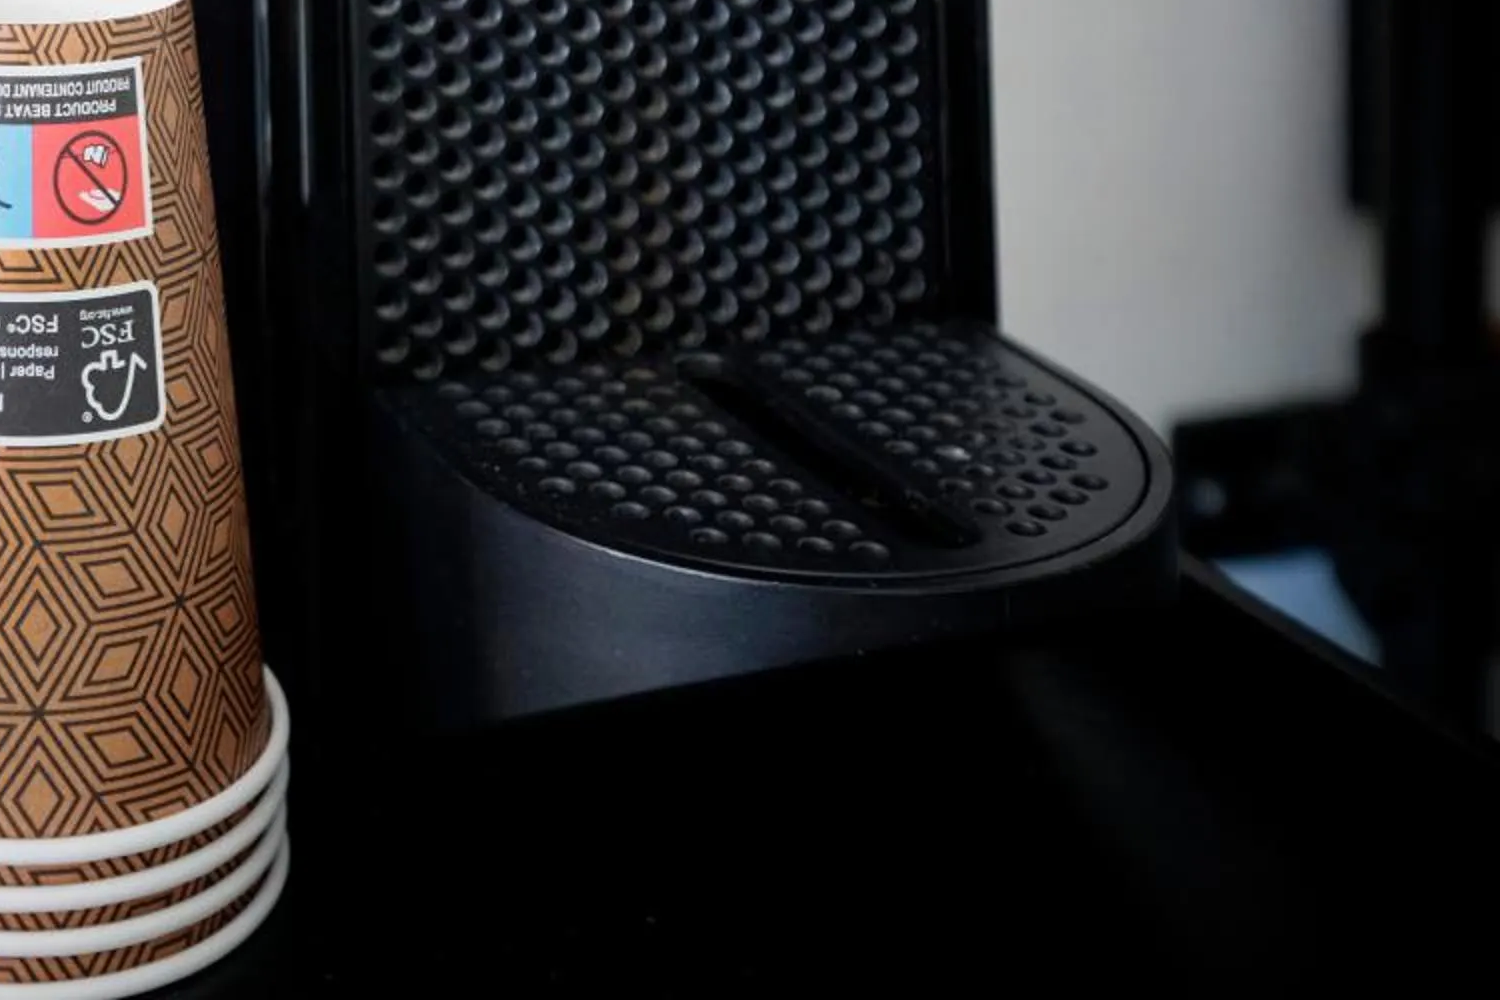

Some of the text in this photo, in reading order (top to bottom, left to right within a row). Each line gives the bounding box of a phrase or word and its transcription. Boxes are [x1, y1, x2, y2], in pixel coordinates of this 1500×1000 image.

[12, 81, 84, 97] CONTENANT
[86, 77, 130, 95] PRODUIT
[4, 102, 50, 117] BEVAT
[54, 98, 117, 116] PRODUCT
[80, 319, 136, 348] FSC
[9, 363, 55, 379] Paper
